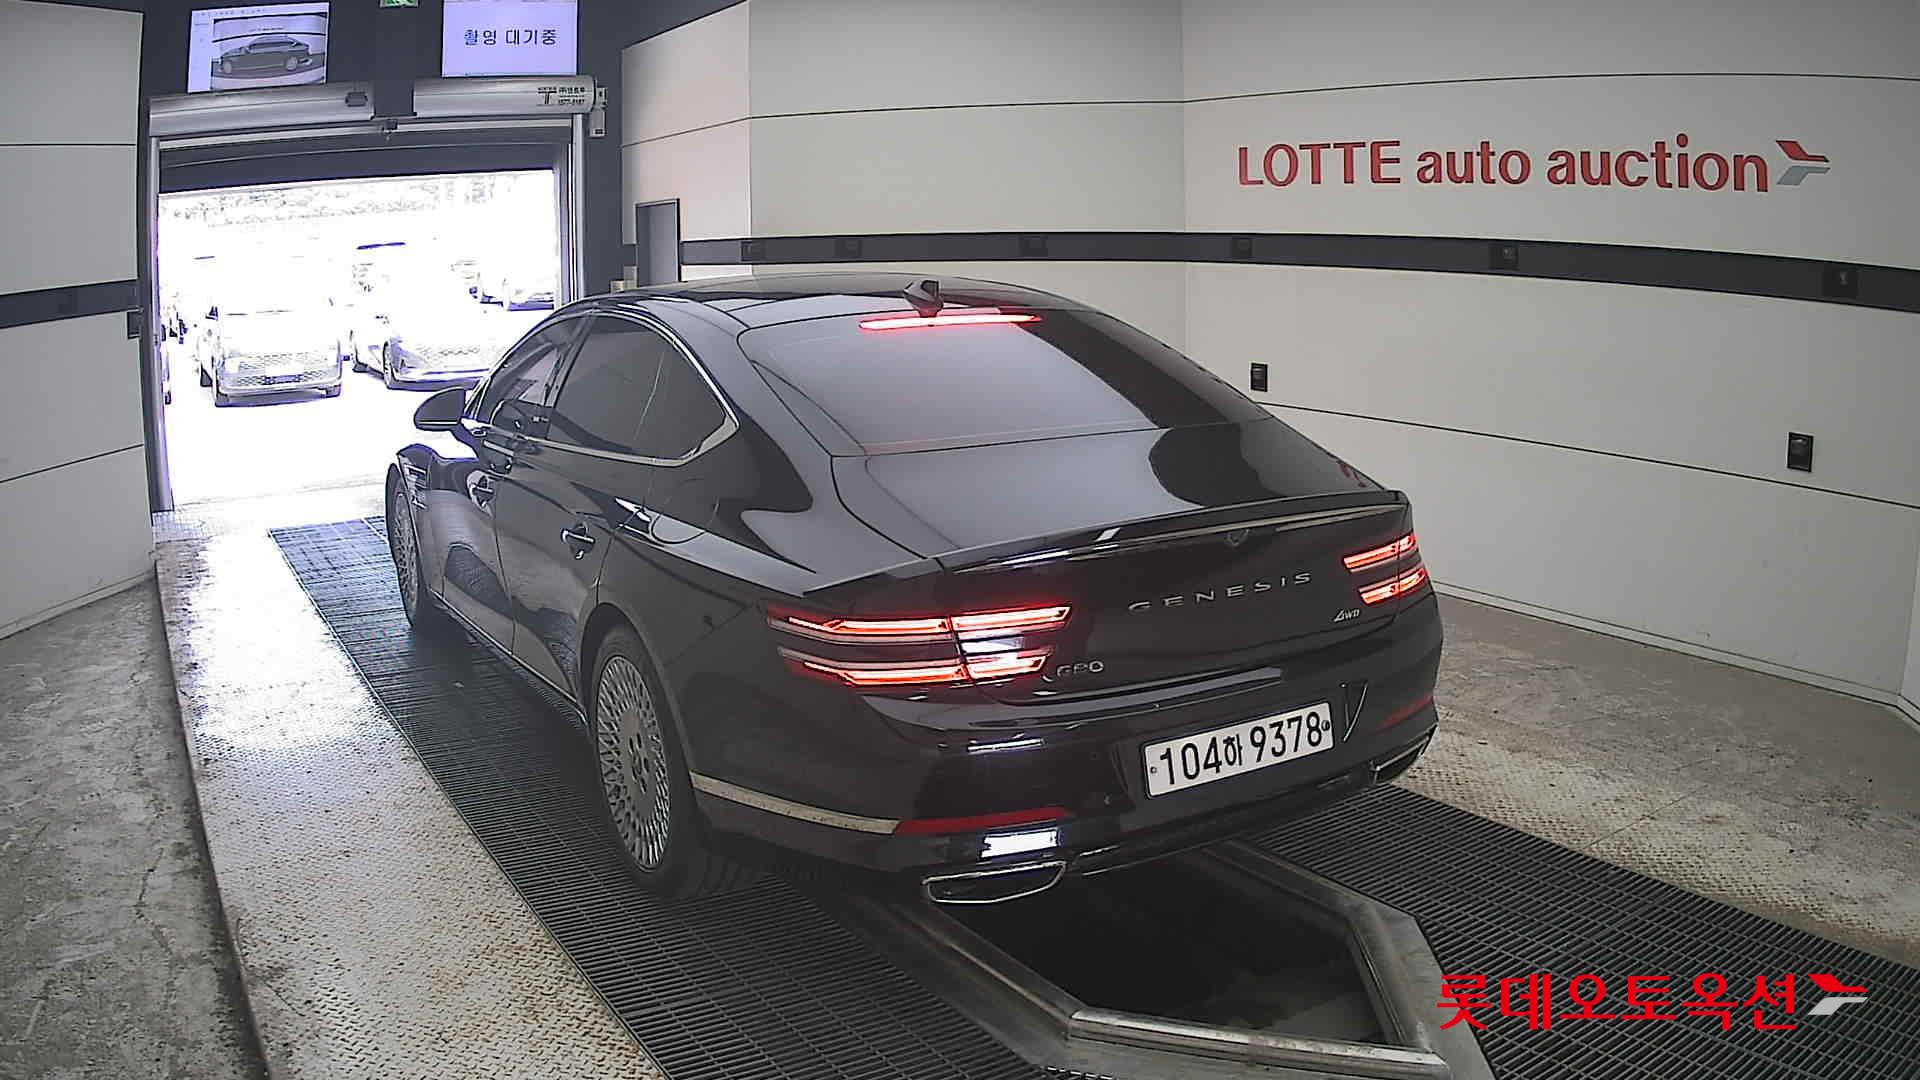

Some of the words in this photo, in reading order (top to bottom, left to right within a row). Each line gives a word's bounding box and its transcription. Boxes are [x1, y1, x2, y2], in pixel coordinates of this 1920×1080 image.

[464, 29, 497, 46] 촬영
[505, 29, 557, 46] 대기중
[1239, 140, 1401, 187] LOTTE
[1416, 140, 1531, 186] auto
[1547, 133, 1769, 193] auction
[1128, 571, 1312, 612] GENESIS
[1159, 733, 1243, 786] 104하
[1249, 711, 1322, 764] 9378
